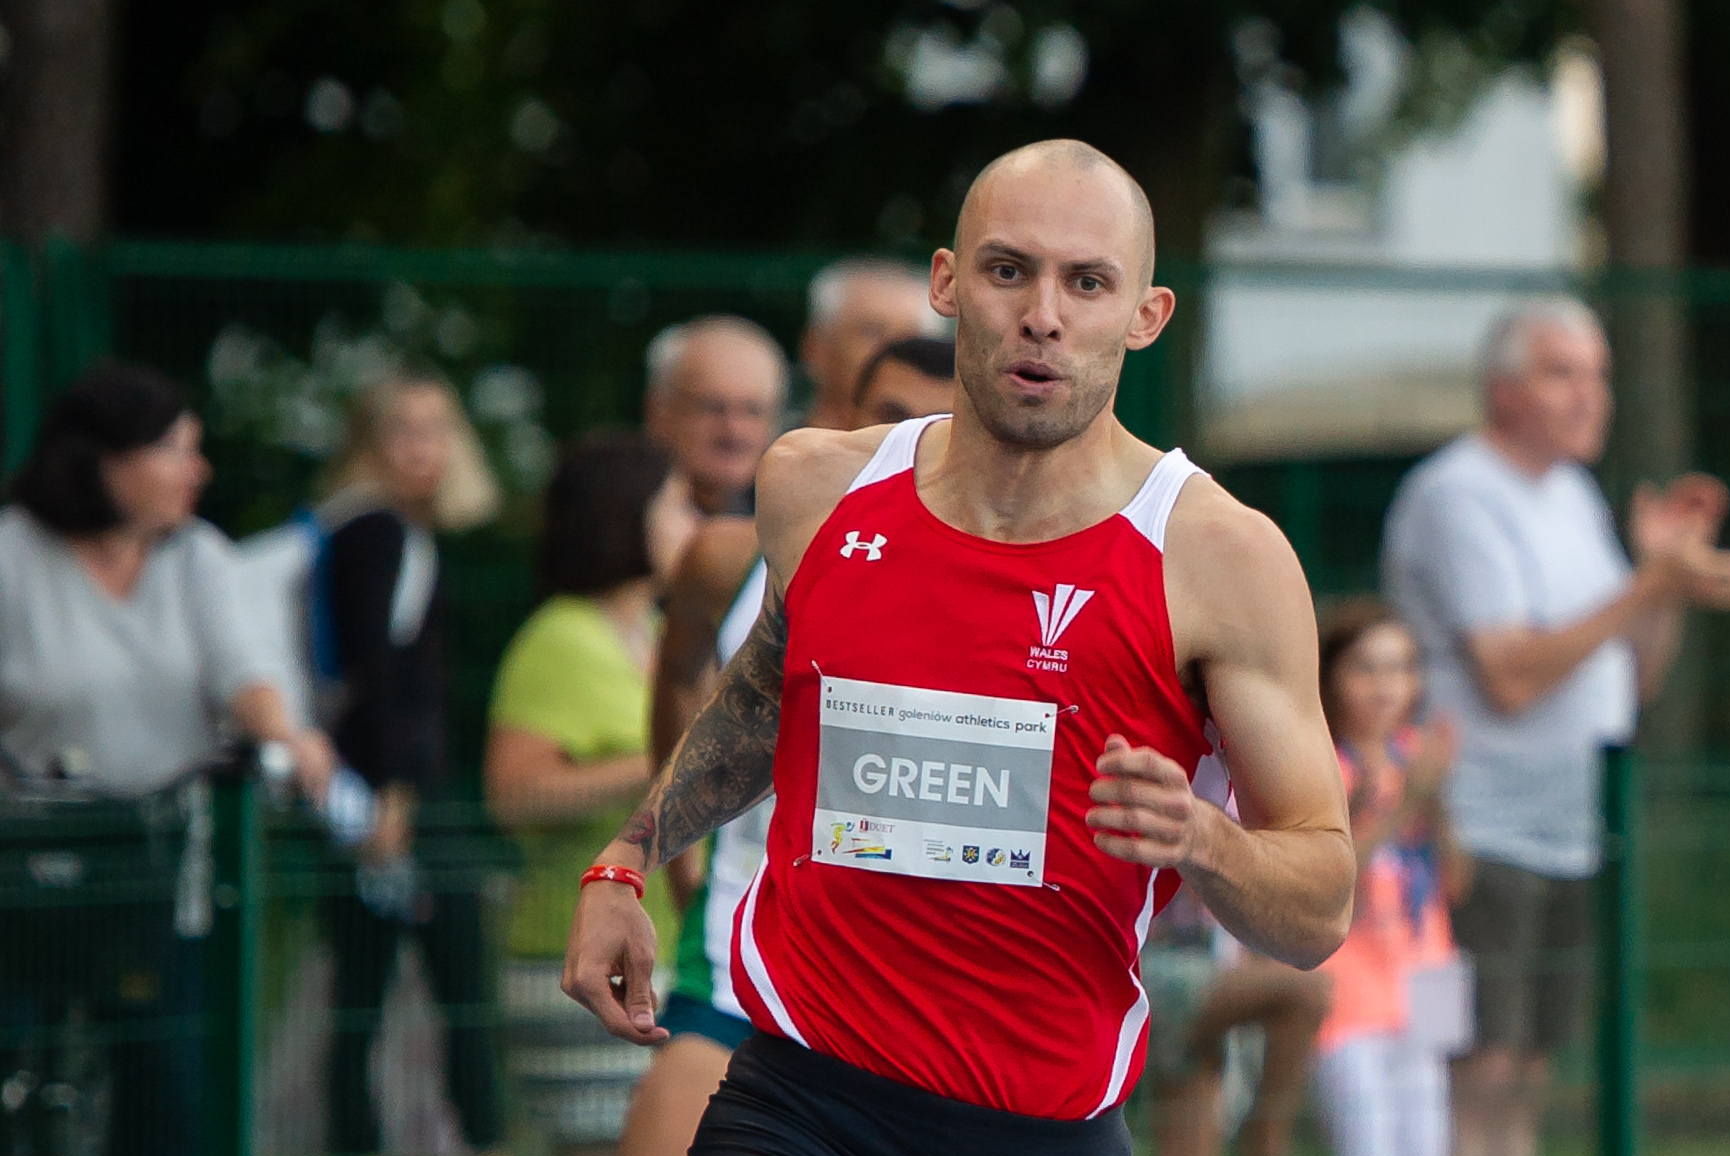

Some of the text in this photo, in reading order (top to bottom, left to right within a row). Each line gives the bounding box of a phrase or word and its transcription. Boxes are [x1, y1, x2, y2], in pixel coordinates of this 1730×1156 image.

[1029, 646, 1068, 661] WALES
[1026, 659, 1068, 673] CYMRU
[826, 699, 1047, 733] BESTSELLER goleniów athletics park
[853, 753, 1011, 808] GREEN
